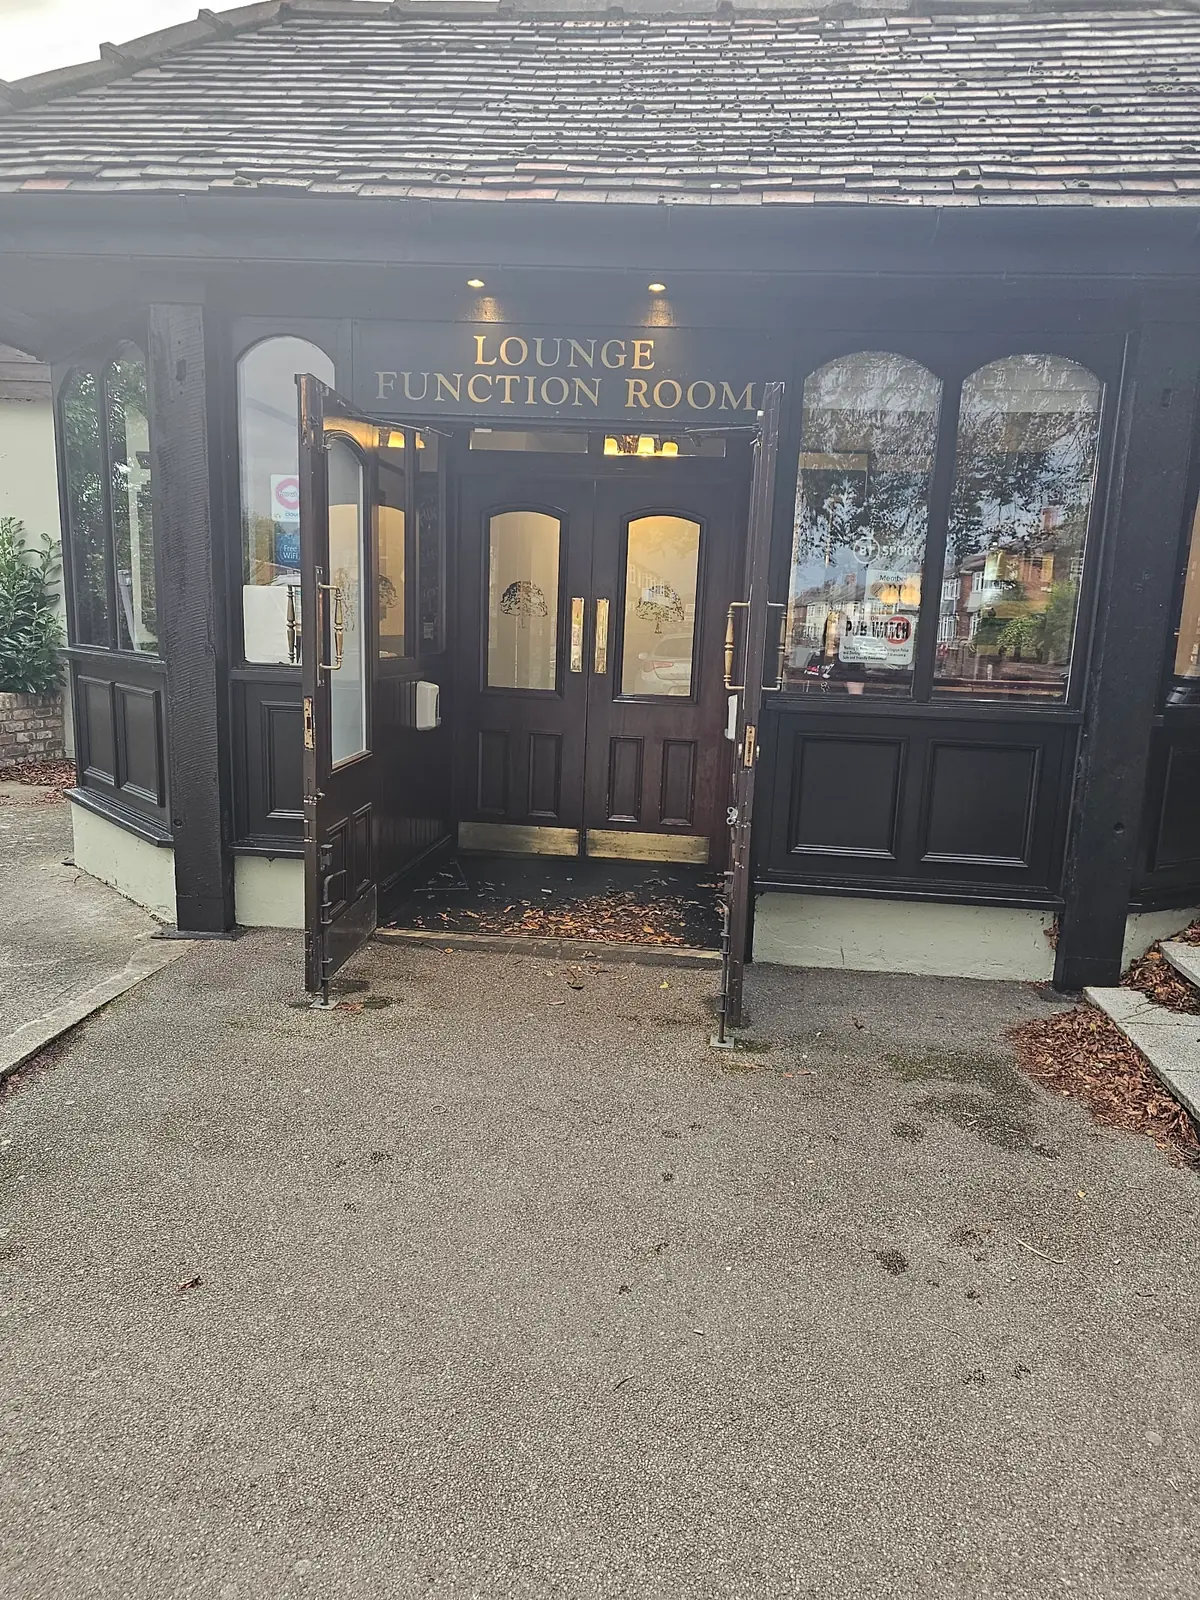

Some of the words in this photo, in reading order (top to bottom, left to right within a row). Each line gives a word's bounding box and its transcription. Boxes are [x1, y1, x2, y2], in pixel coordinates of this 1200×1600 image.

[473, 335, 656, 370] LOUNGE
[375, 371, 602, 407] FUNCTION
[625, 378, 757, 411] ROOM
[881, 545, 920, 556] SPORT
[845, 620, 867, 637] PUB
